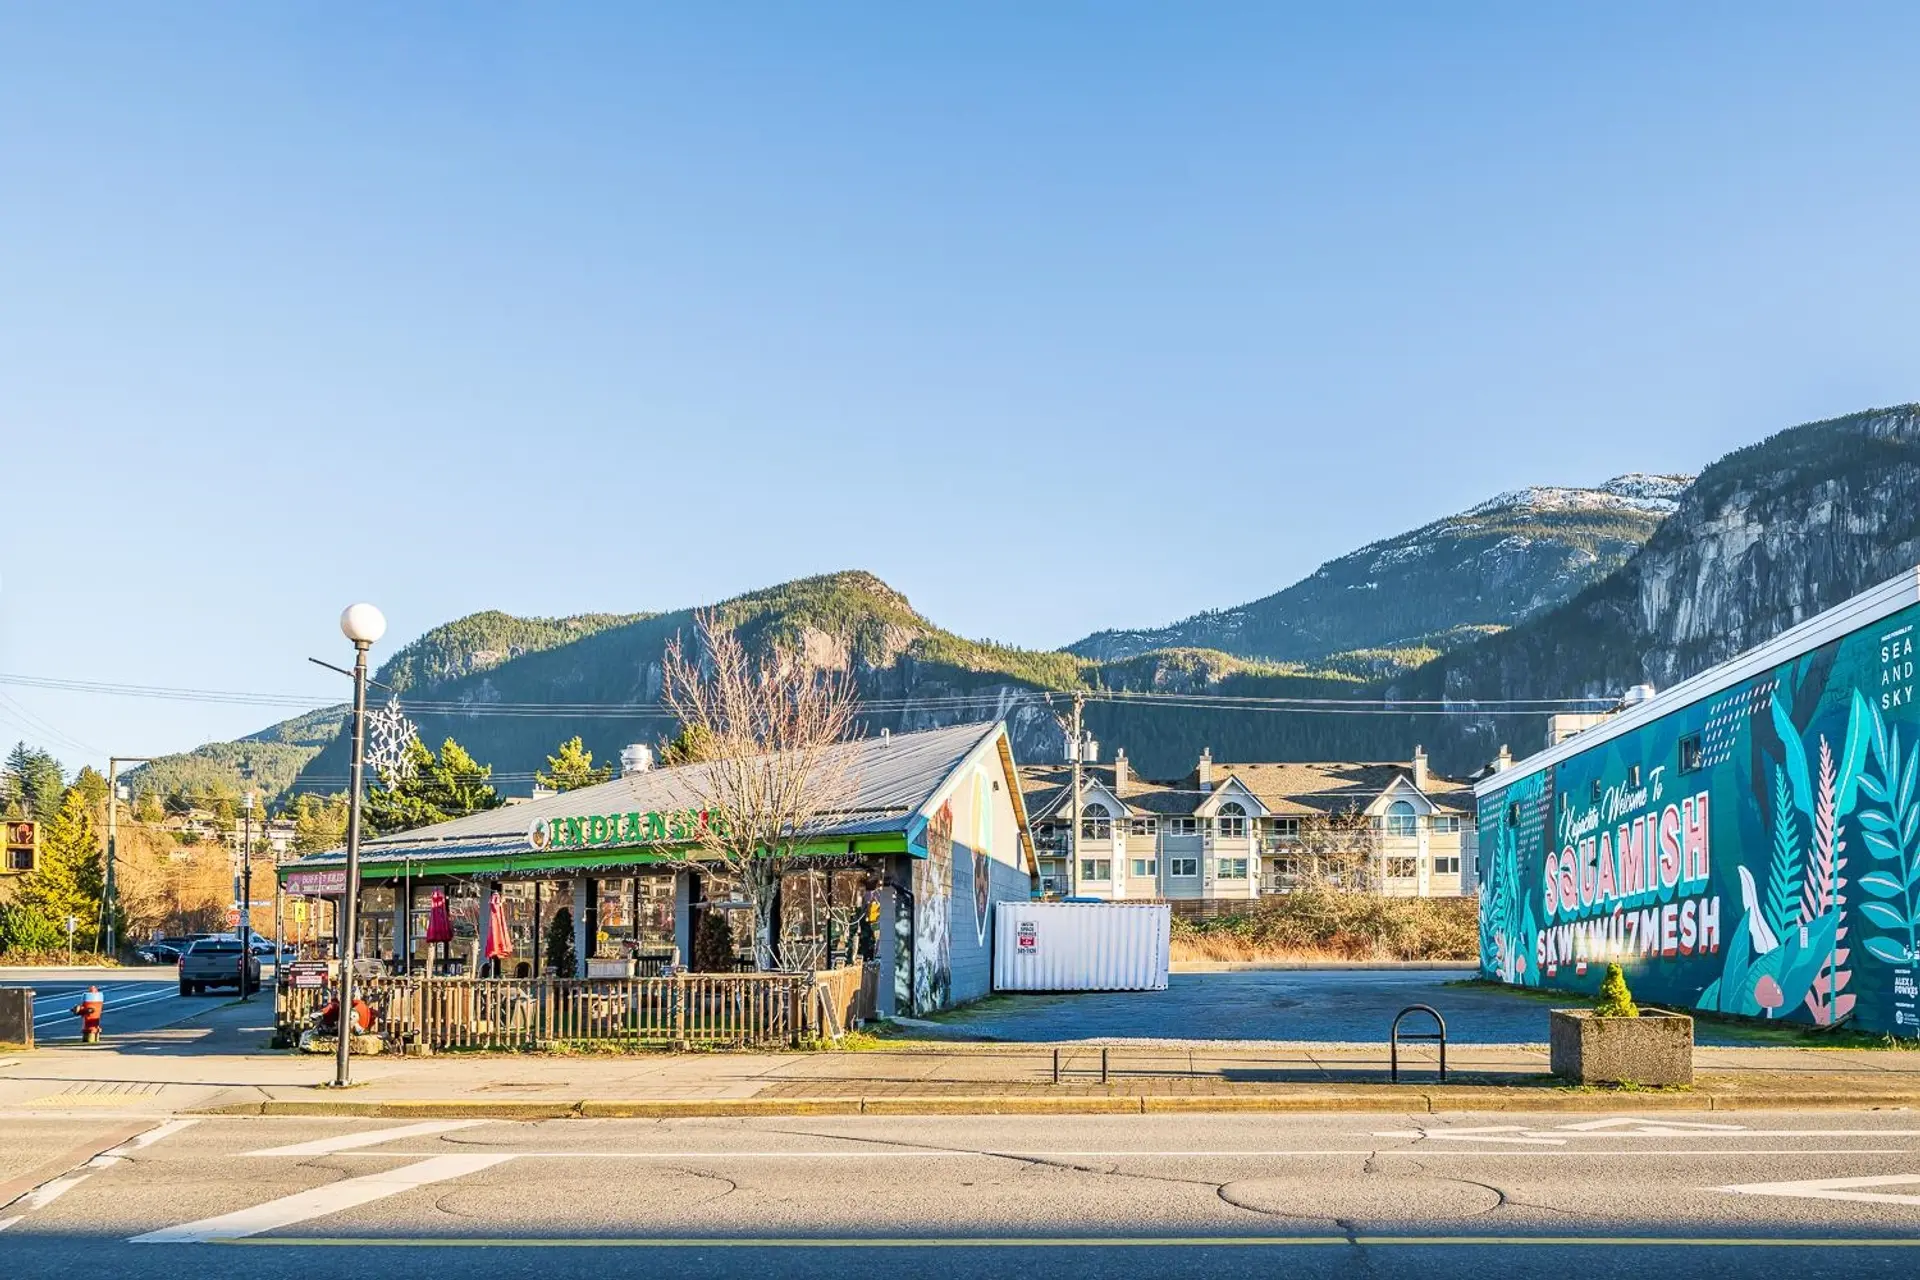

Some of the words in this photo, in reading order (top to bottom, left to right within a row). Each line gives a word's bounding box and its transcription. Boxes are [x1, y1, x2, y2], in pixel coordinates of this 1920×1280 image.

[1881, 637, 1913, 663] SEA
[1881, 661, 1913, 687] AND
[1881, 685, 1913, 710] SKY
[1601, 780, 1648, 824] Welcome
[1649, 765, 1665, 802] To
[1544, 790, 1710, 915] SQUAMISH
